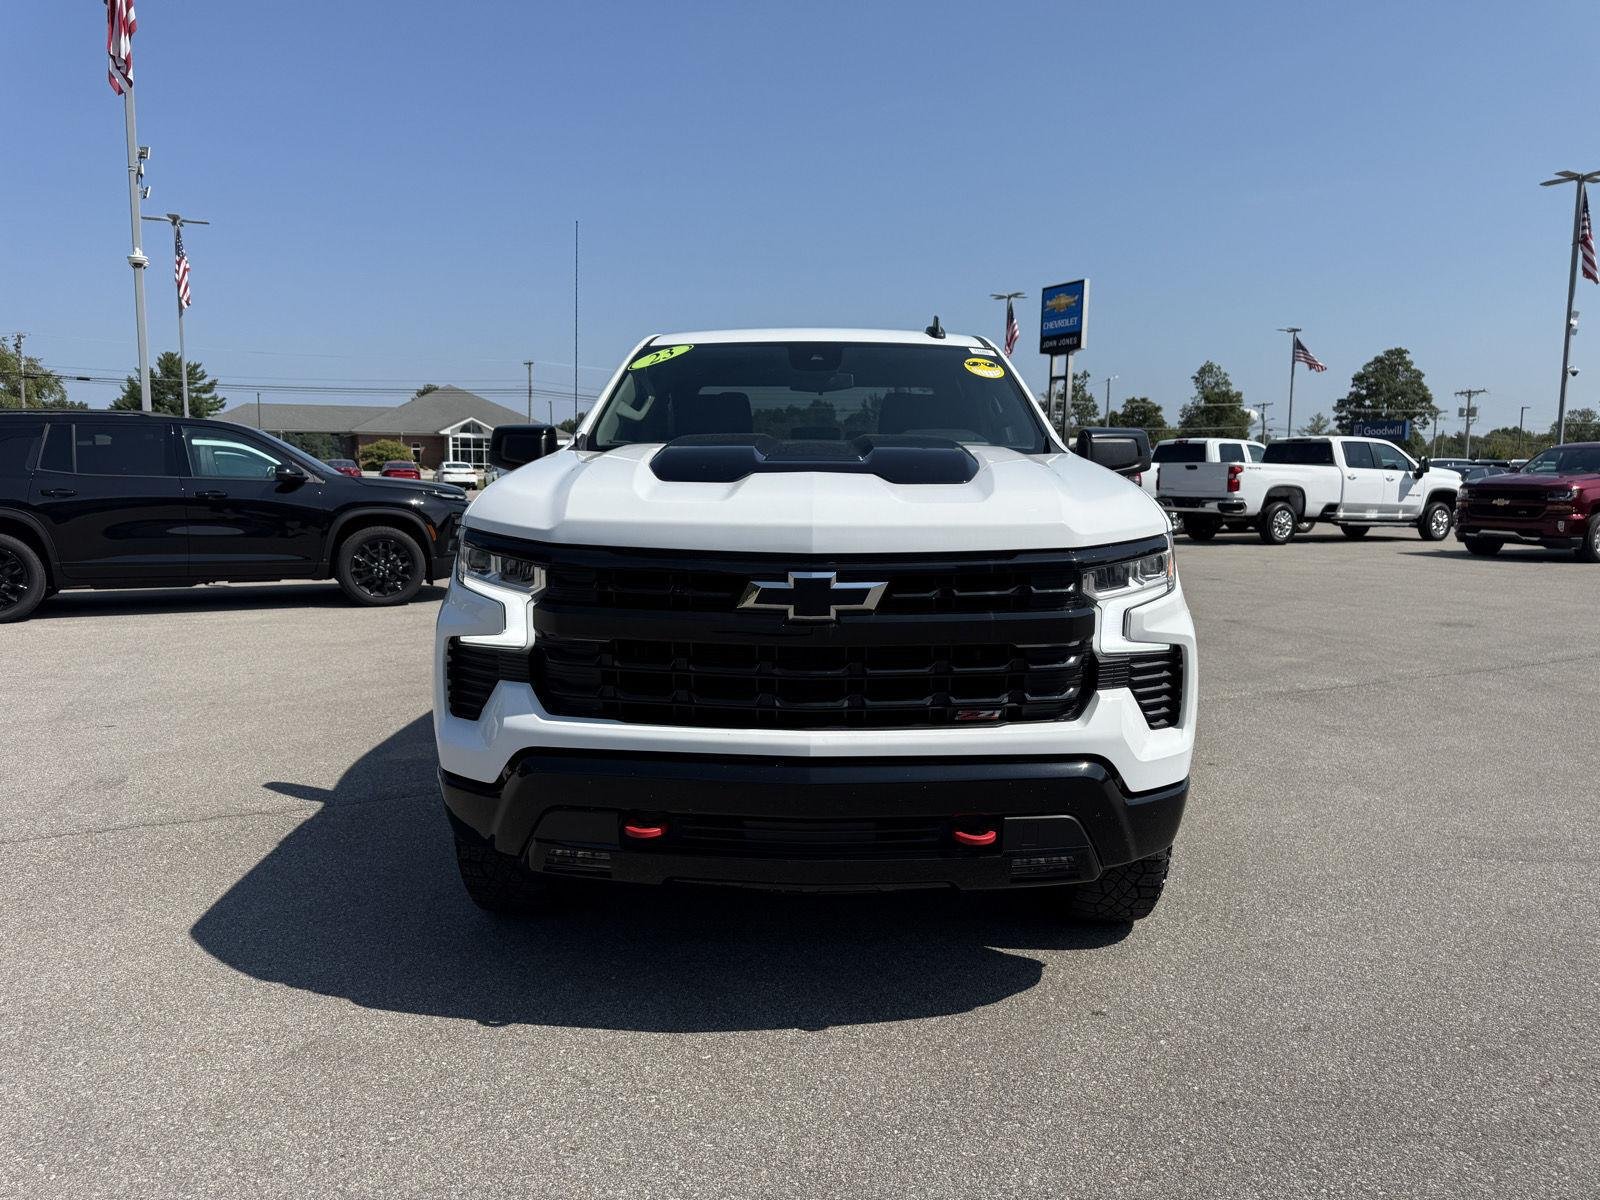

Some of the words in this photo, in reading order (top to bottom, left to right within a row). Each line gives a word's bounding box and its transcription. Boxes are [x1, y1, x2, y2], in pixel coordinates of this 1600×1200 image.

[1043, 317, 1078, 330] CHEVROLET
[1043, 340, 1057, 349] JOHN
[1058, 336, 1078, 346] JONES
[649, 348, 674, 364] 23
[1363, 425, 1402, 436] Goodwill
